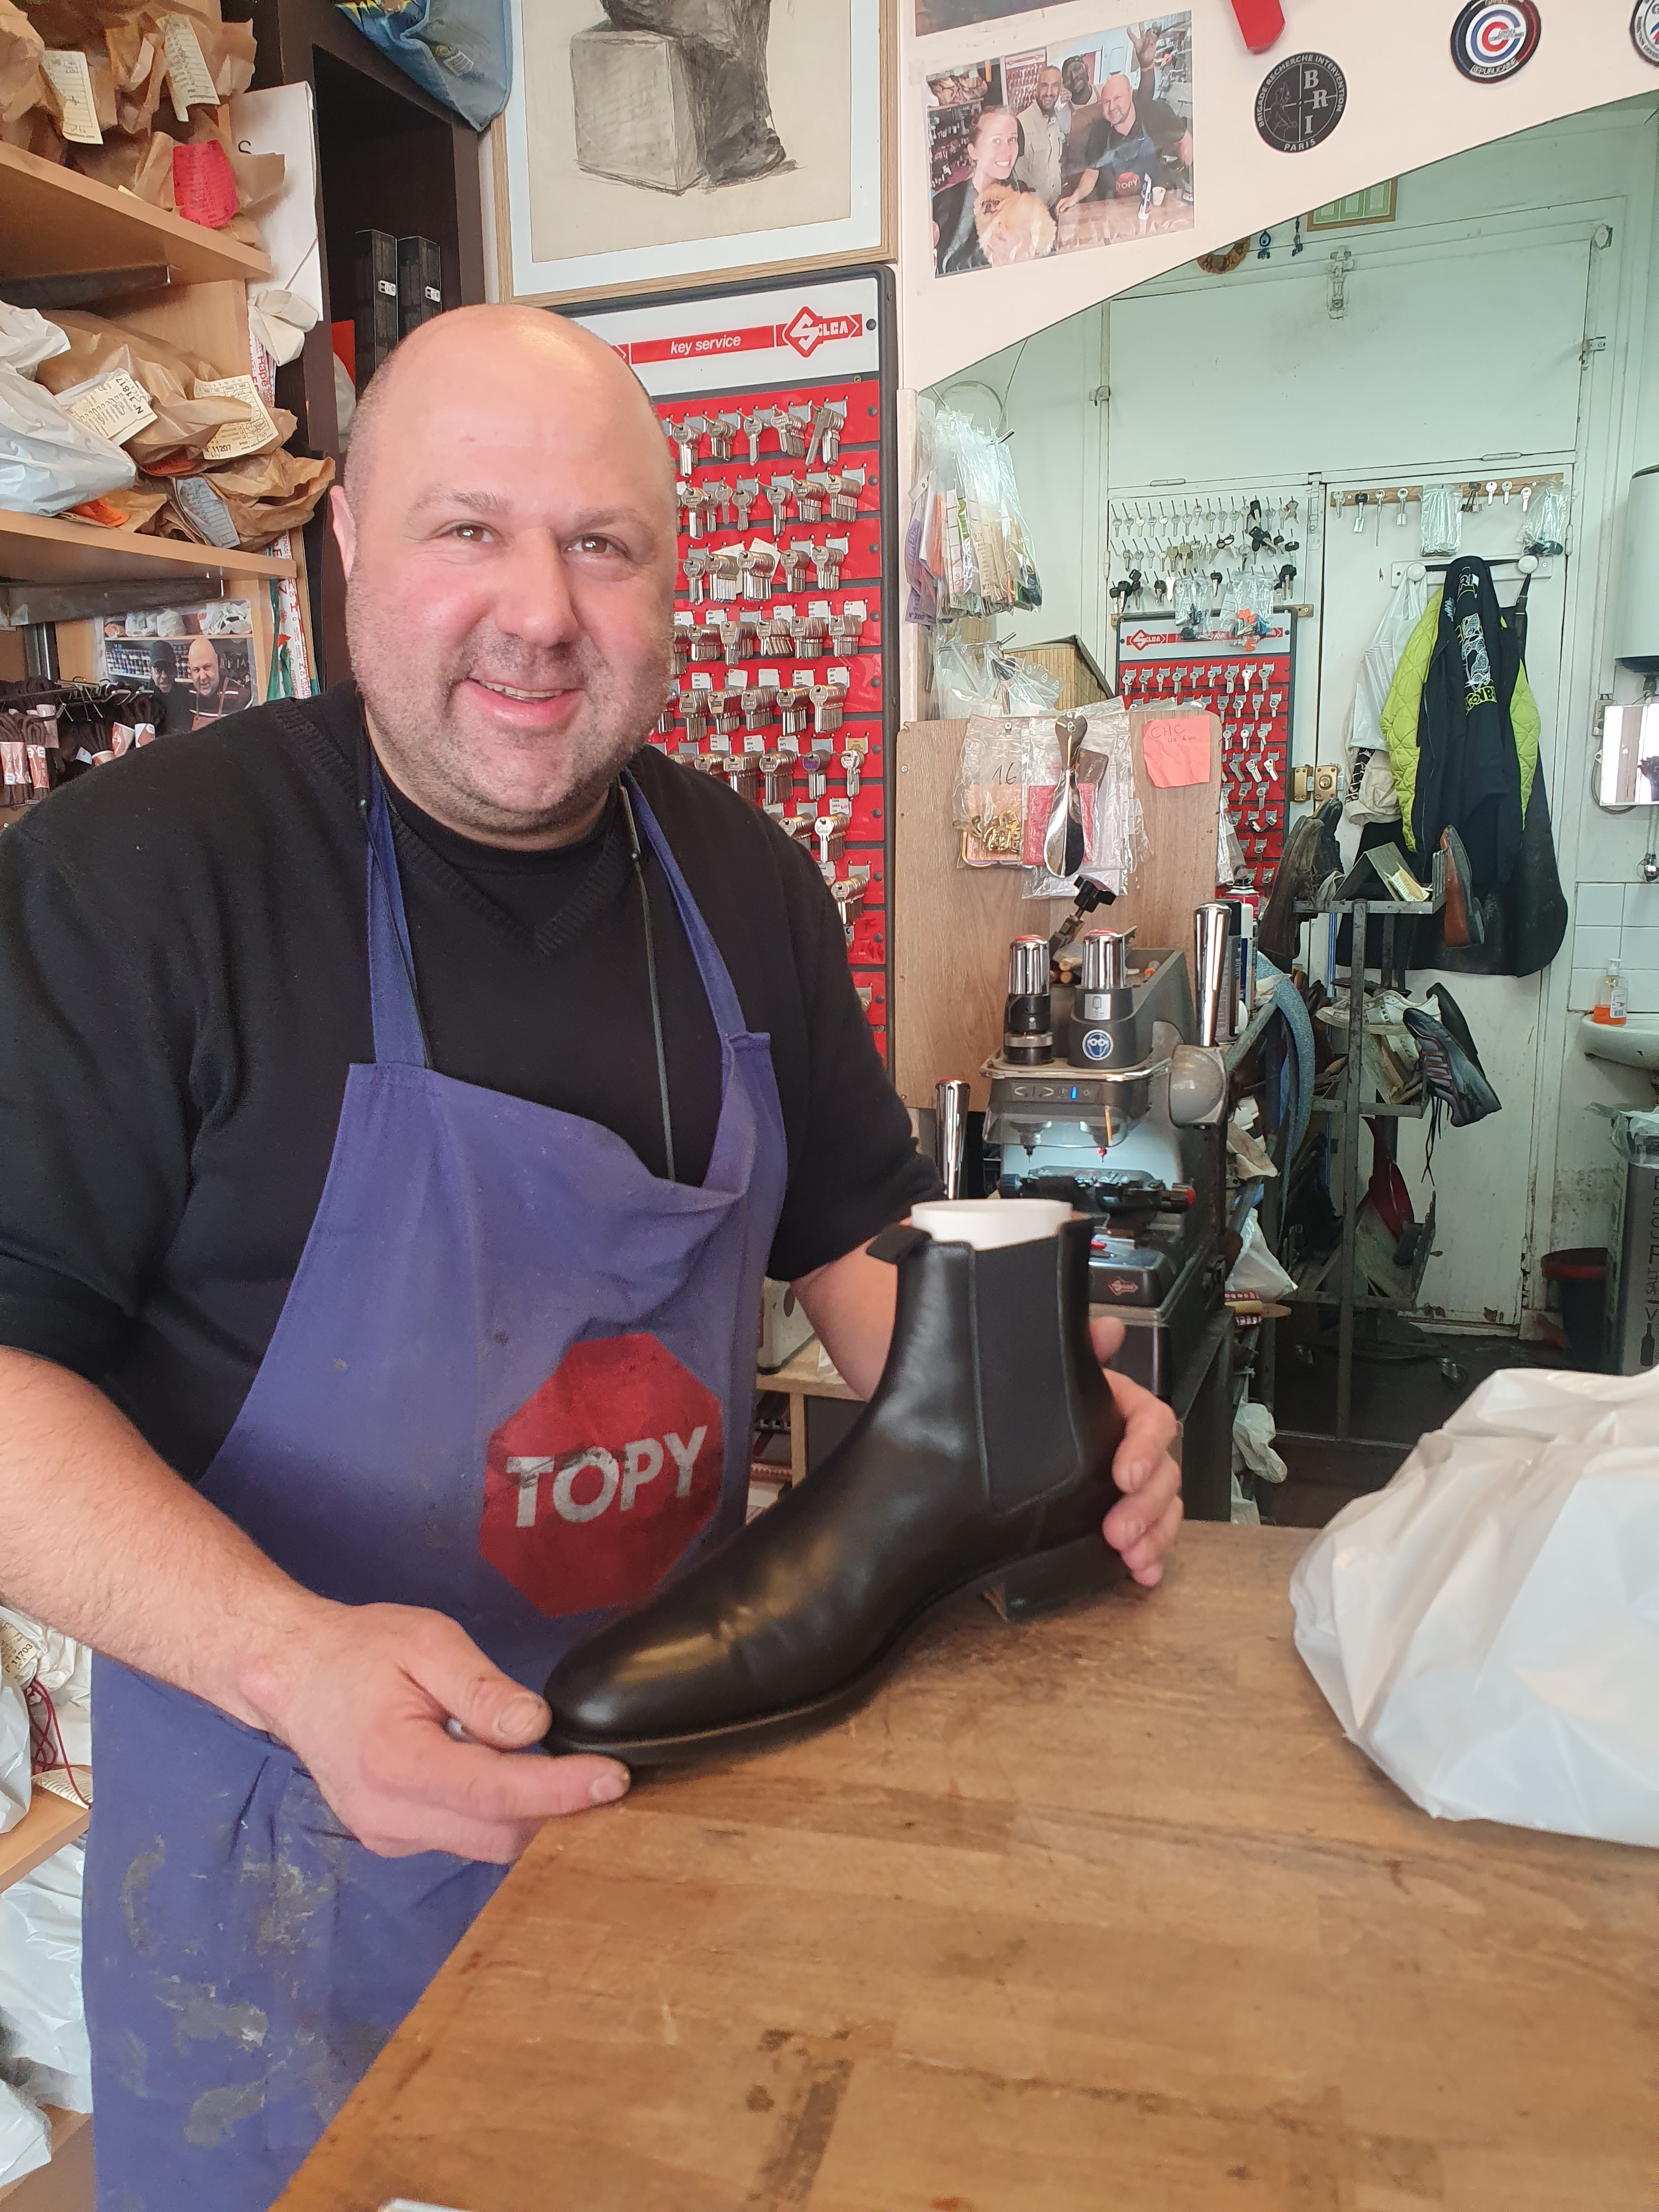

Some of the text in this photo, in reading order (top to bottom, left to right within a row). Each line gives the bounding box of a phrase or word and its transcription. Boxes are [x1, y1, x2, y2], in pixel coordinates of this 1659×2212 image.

[1257, 54, 1345, 128] BRIGADE RECHERCHE INTERVENTION
[1283, 138, 1316, 151] PARIS
[789, 313, 849, 352] SILCA
[670, 334, 741, 356] key service
[115, 377, 136, 403] 11817
[212, 444, 232, 453] 11207
[991, 761, 1017, 785] 16
[506, 1425, 708, 1528] TOPY
[11, 1643, 33, 1664] 11703
